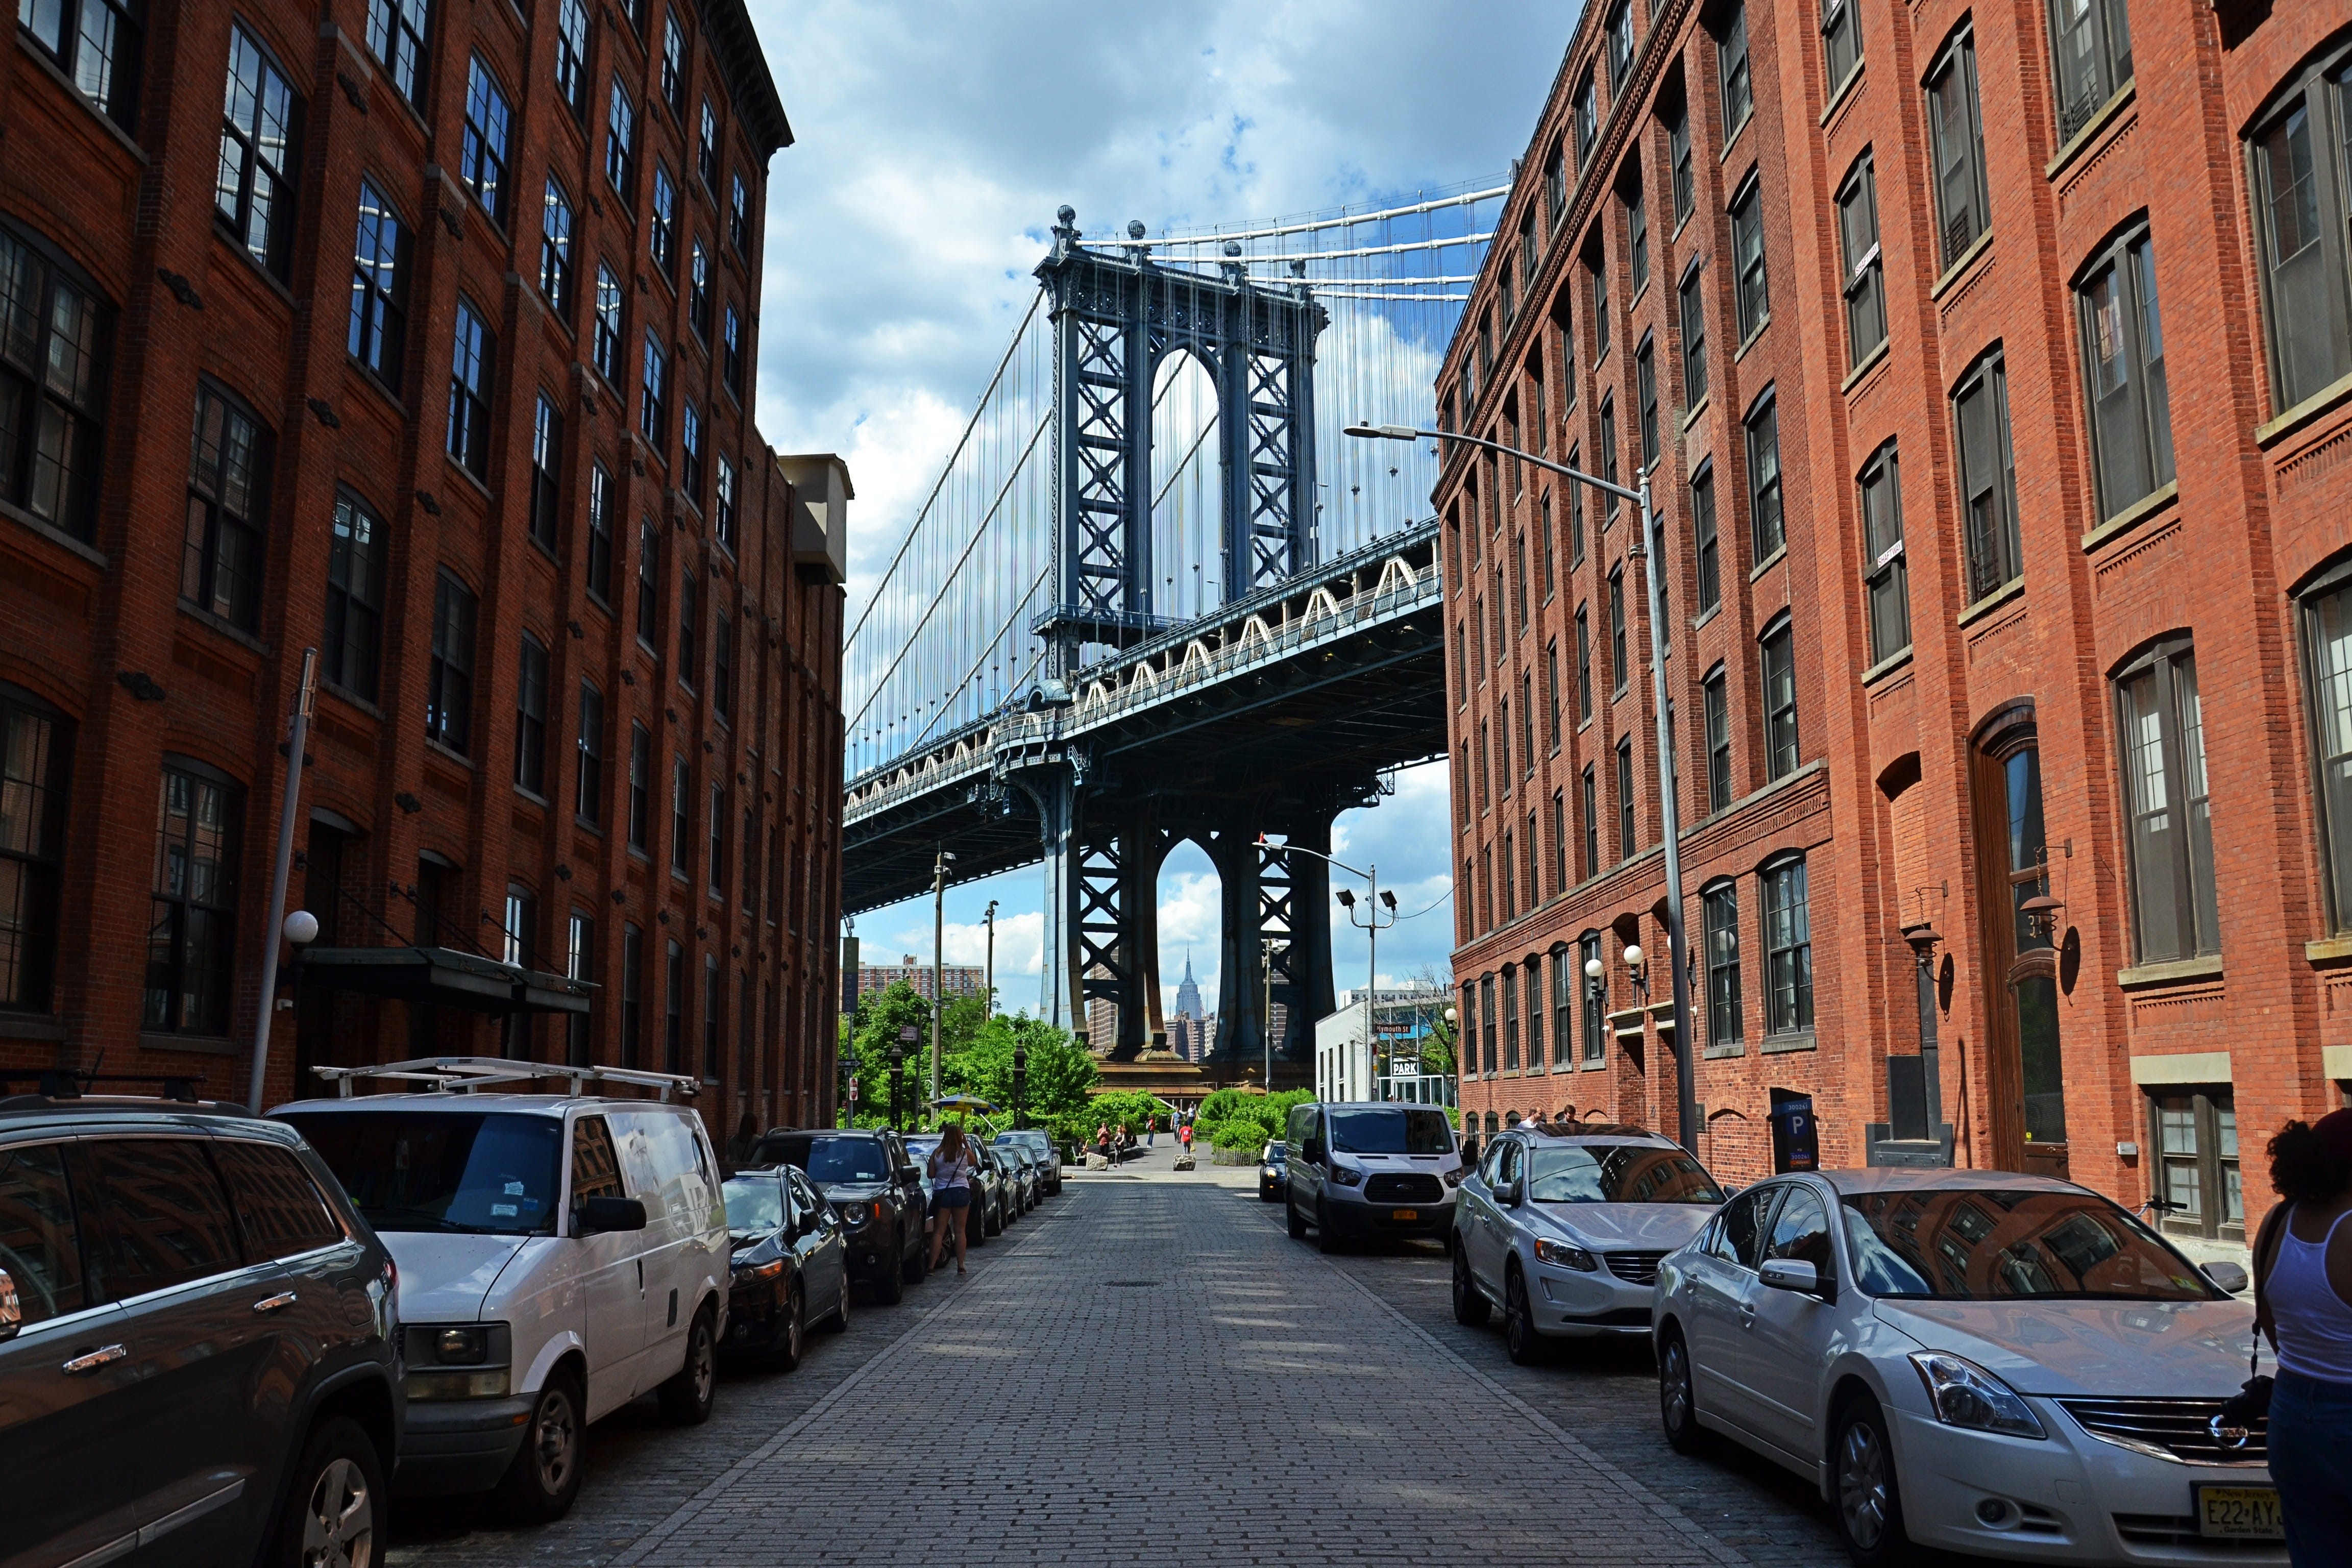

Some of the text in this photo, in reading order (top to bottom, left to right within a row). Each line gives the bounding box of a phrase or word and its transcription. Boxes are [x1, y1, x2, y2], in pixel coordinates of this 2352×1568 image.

[1855, 244, 1877, 275] SHAFTWAY
[1878, 543, 1901, 567] SHAFTWAY
[1393, 1063, 1417, 1074] PARK
[1792, 1116, 1804, 1134] P
[2244, 1489, 2270, 1499] Jersey
